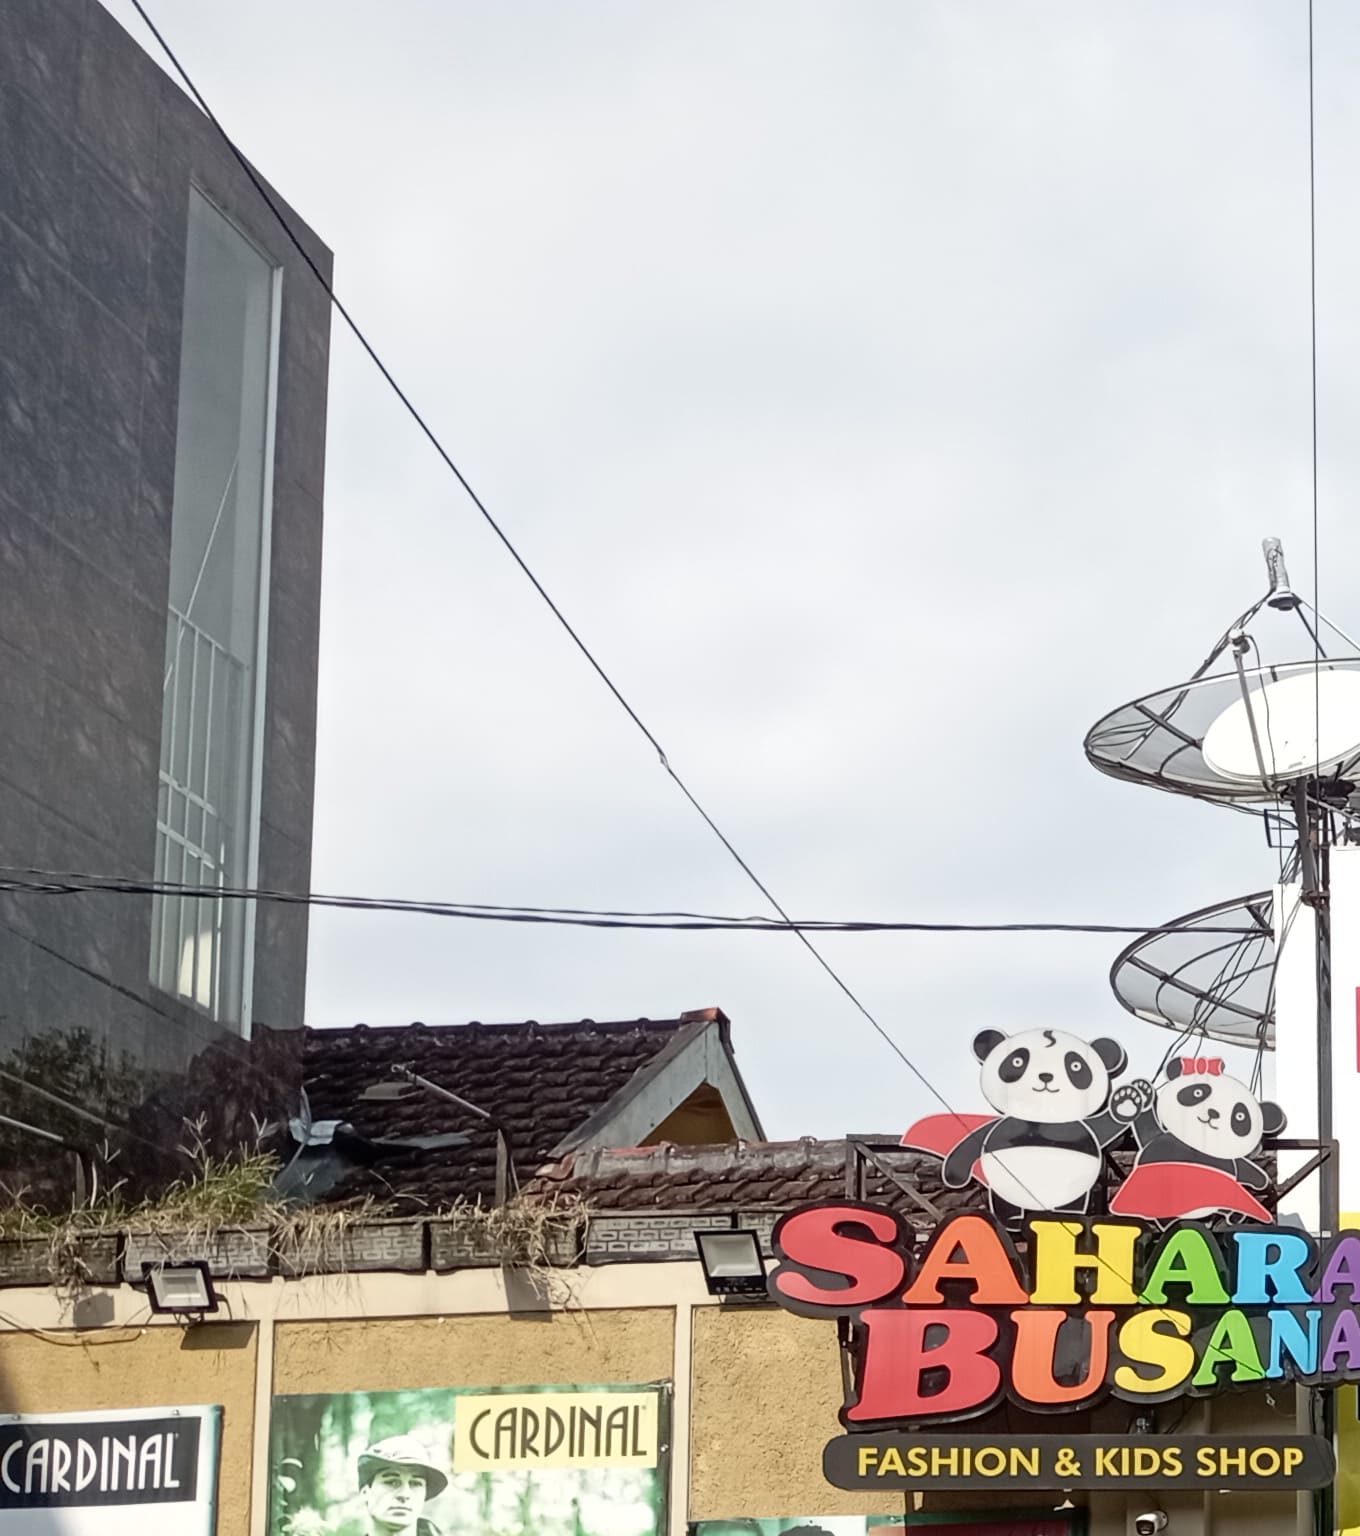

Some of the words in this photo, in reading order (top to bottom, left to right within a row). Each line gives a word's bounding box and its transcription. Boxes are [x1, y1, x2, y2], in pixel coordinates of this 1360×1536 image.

[469, 1404, 647, 1460] CARDINAL
[1, 1432, 180, 1494] CARDINAL
[857, 1447, 1040, 1477] FASHION
[1053, 1446, 1082, 1477] &
[1095, 1447, 1184, 1477] KIDS
[1196, 1447, 1304, 1477] SHOP
